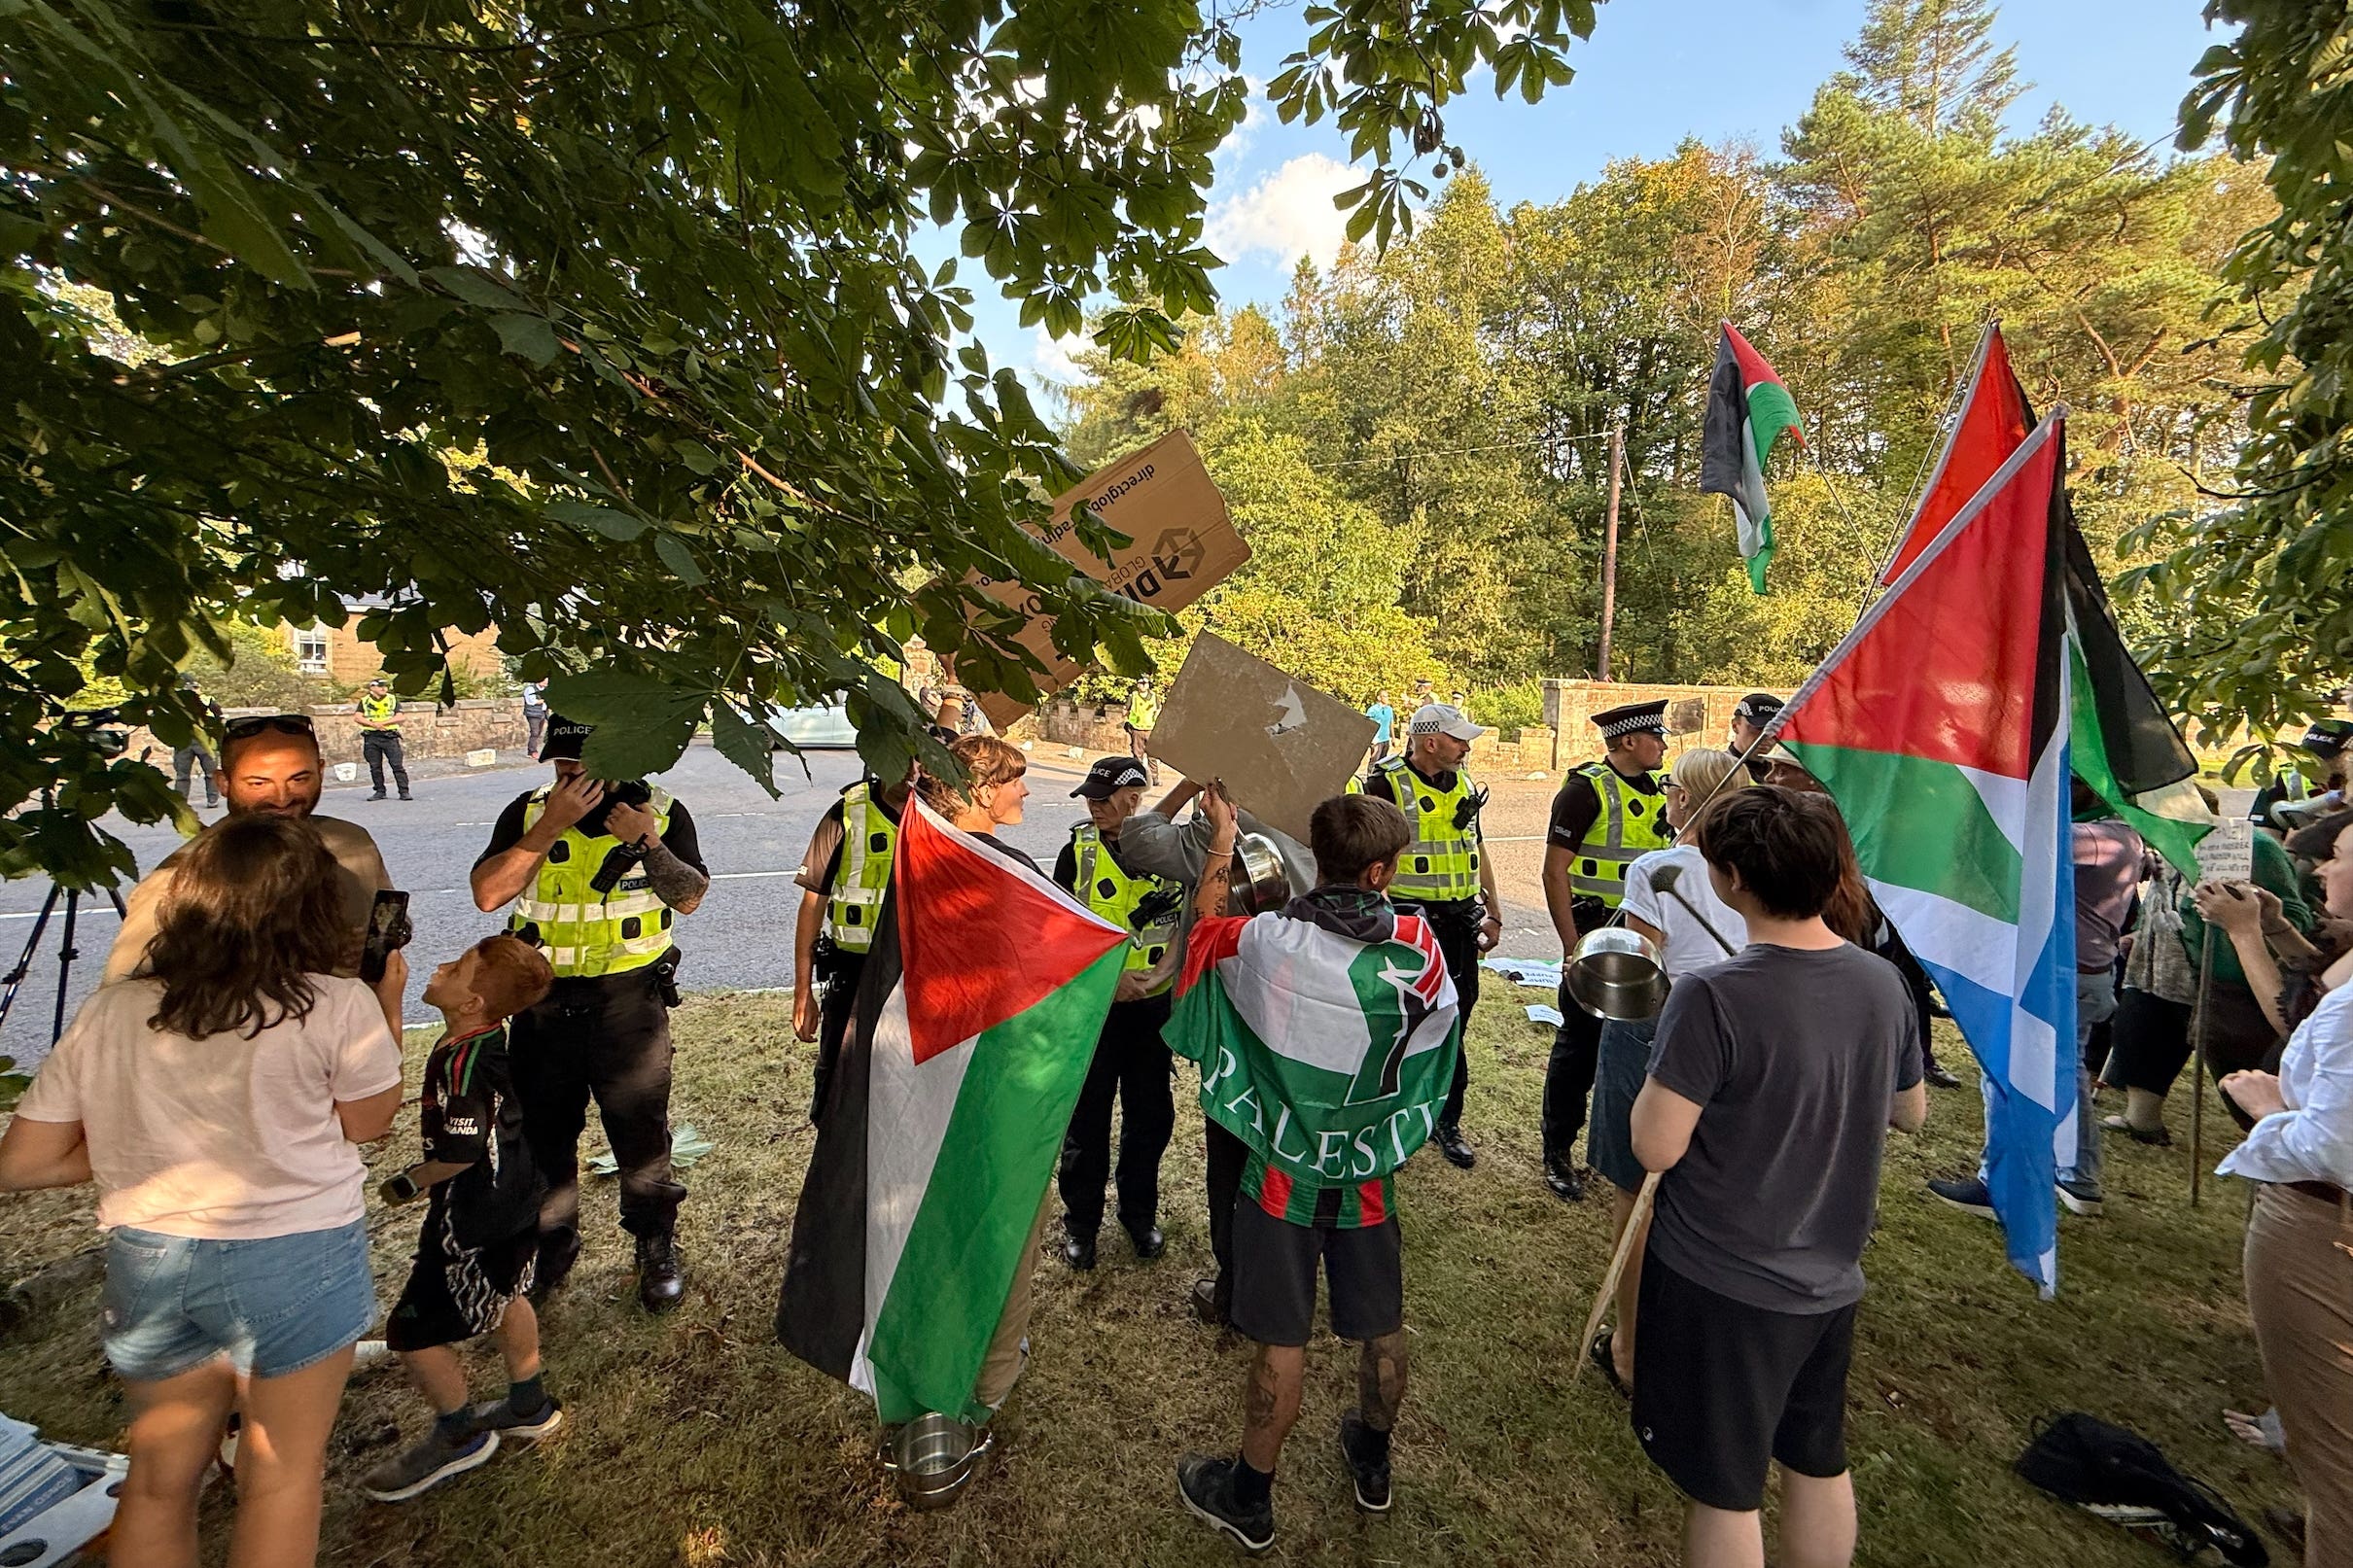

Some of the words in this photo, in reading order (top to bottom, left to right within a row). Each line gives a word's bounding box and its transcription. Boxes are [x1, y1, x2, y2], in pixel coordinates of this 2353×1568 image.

[1104, 555, 1146, 589] GLOBA
[621, 879, 650, 889] POLIC
[1202, 1045, 1449, 1180] PALESTI
[449, 1117, 474, 1126] VISIT
[443, 1124, 478, 1135] ANDA
